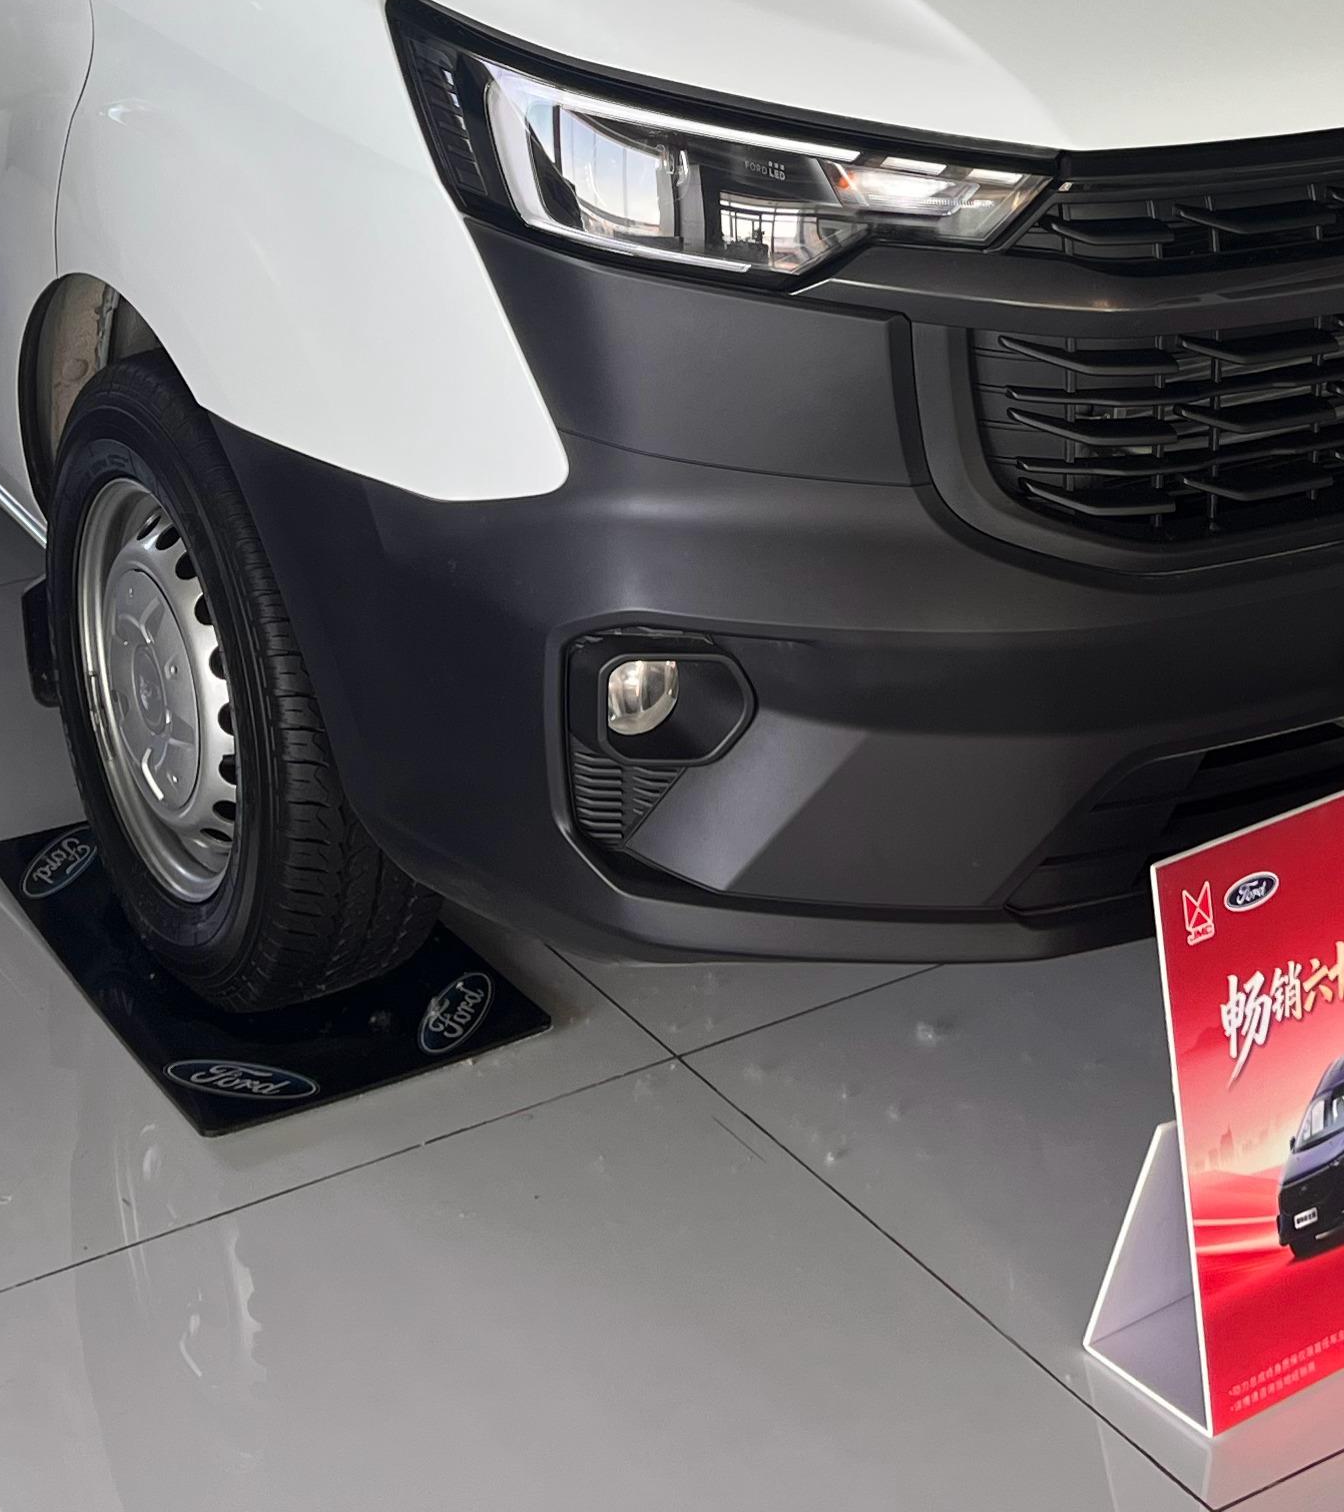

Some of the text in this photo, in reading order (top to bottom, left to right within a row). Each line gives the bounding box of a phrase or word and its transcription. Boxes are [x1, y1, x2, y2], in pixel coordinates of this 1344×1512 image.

[32, 837, 91, 885] Ford
[1236, 879, 1268, 905] Ford
[429, 981, 485, 1038] Ford
[189, 1064, 292, 1096] Ford
